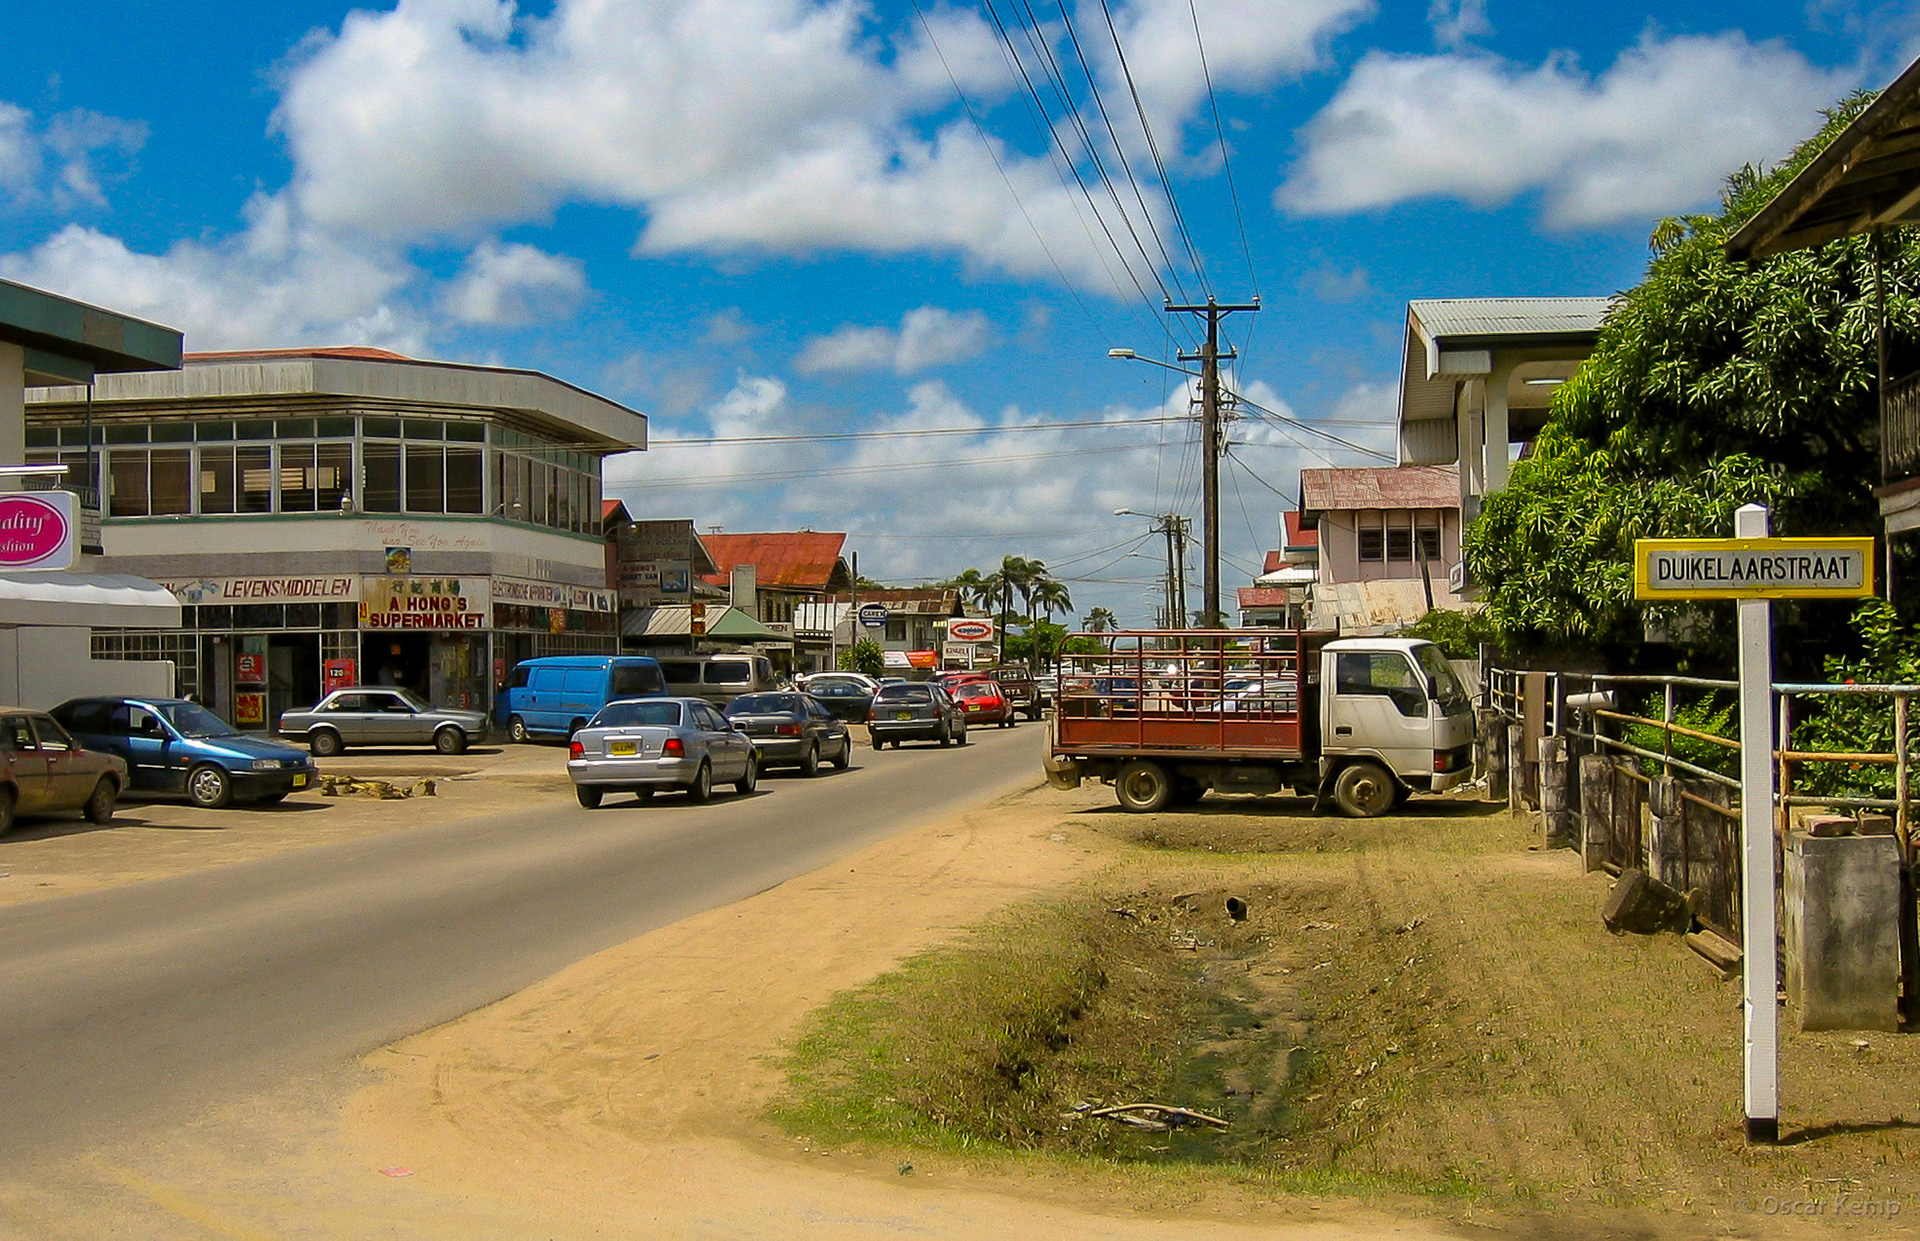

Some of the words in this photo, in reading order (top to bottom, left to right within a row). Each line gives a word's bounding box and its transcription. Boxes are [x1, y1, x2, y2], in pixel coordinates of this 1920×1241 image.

[0, 538, 34, 552] shion
[1658, 556, 1851, 581] DUIKELAARSTRAAT
[223, 578, 352, 598] LEVENSMIDDELEN
[389, 596, 400, 611] A
[407, 596, 467, 612] HONG'S
[370, 613, 485, 628] SUPERMARKET
